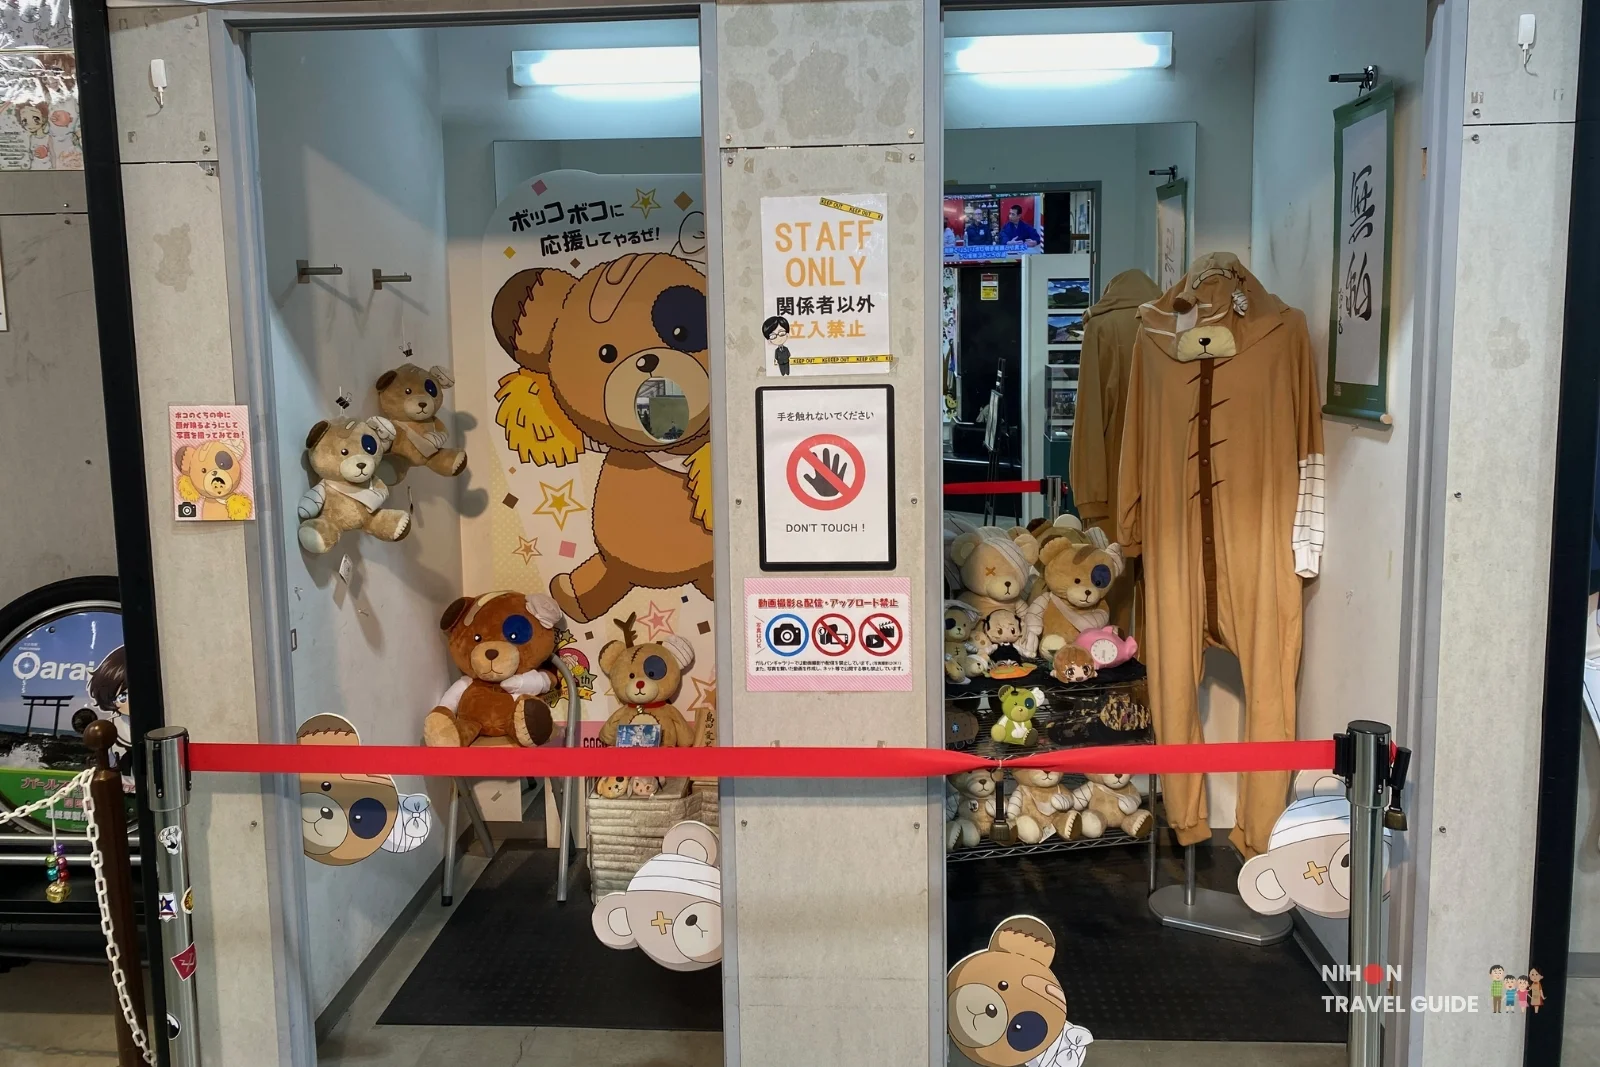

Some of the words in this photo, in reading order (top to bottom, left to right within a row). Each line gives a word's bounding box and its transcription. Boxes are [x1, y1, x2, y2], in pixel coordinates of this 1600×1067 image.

[509, 201, 625, 232] ボッコボコに
[540, 227, 660, 257] 応援してやるぜ!
[775, 220, 875, 252] STAFF
[785, 256, 867, 288] ONLY
[776, 295, 875, 316] 関係者以外
[789, 320, 867, 340] 立入禁止
[777, 410, 875, 422] 手を触れないでください
[786, 524, 818, 533] DON'T
[822, 524, 858, 533] TOUCH
